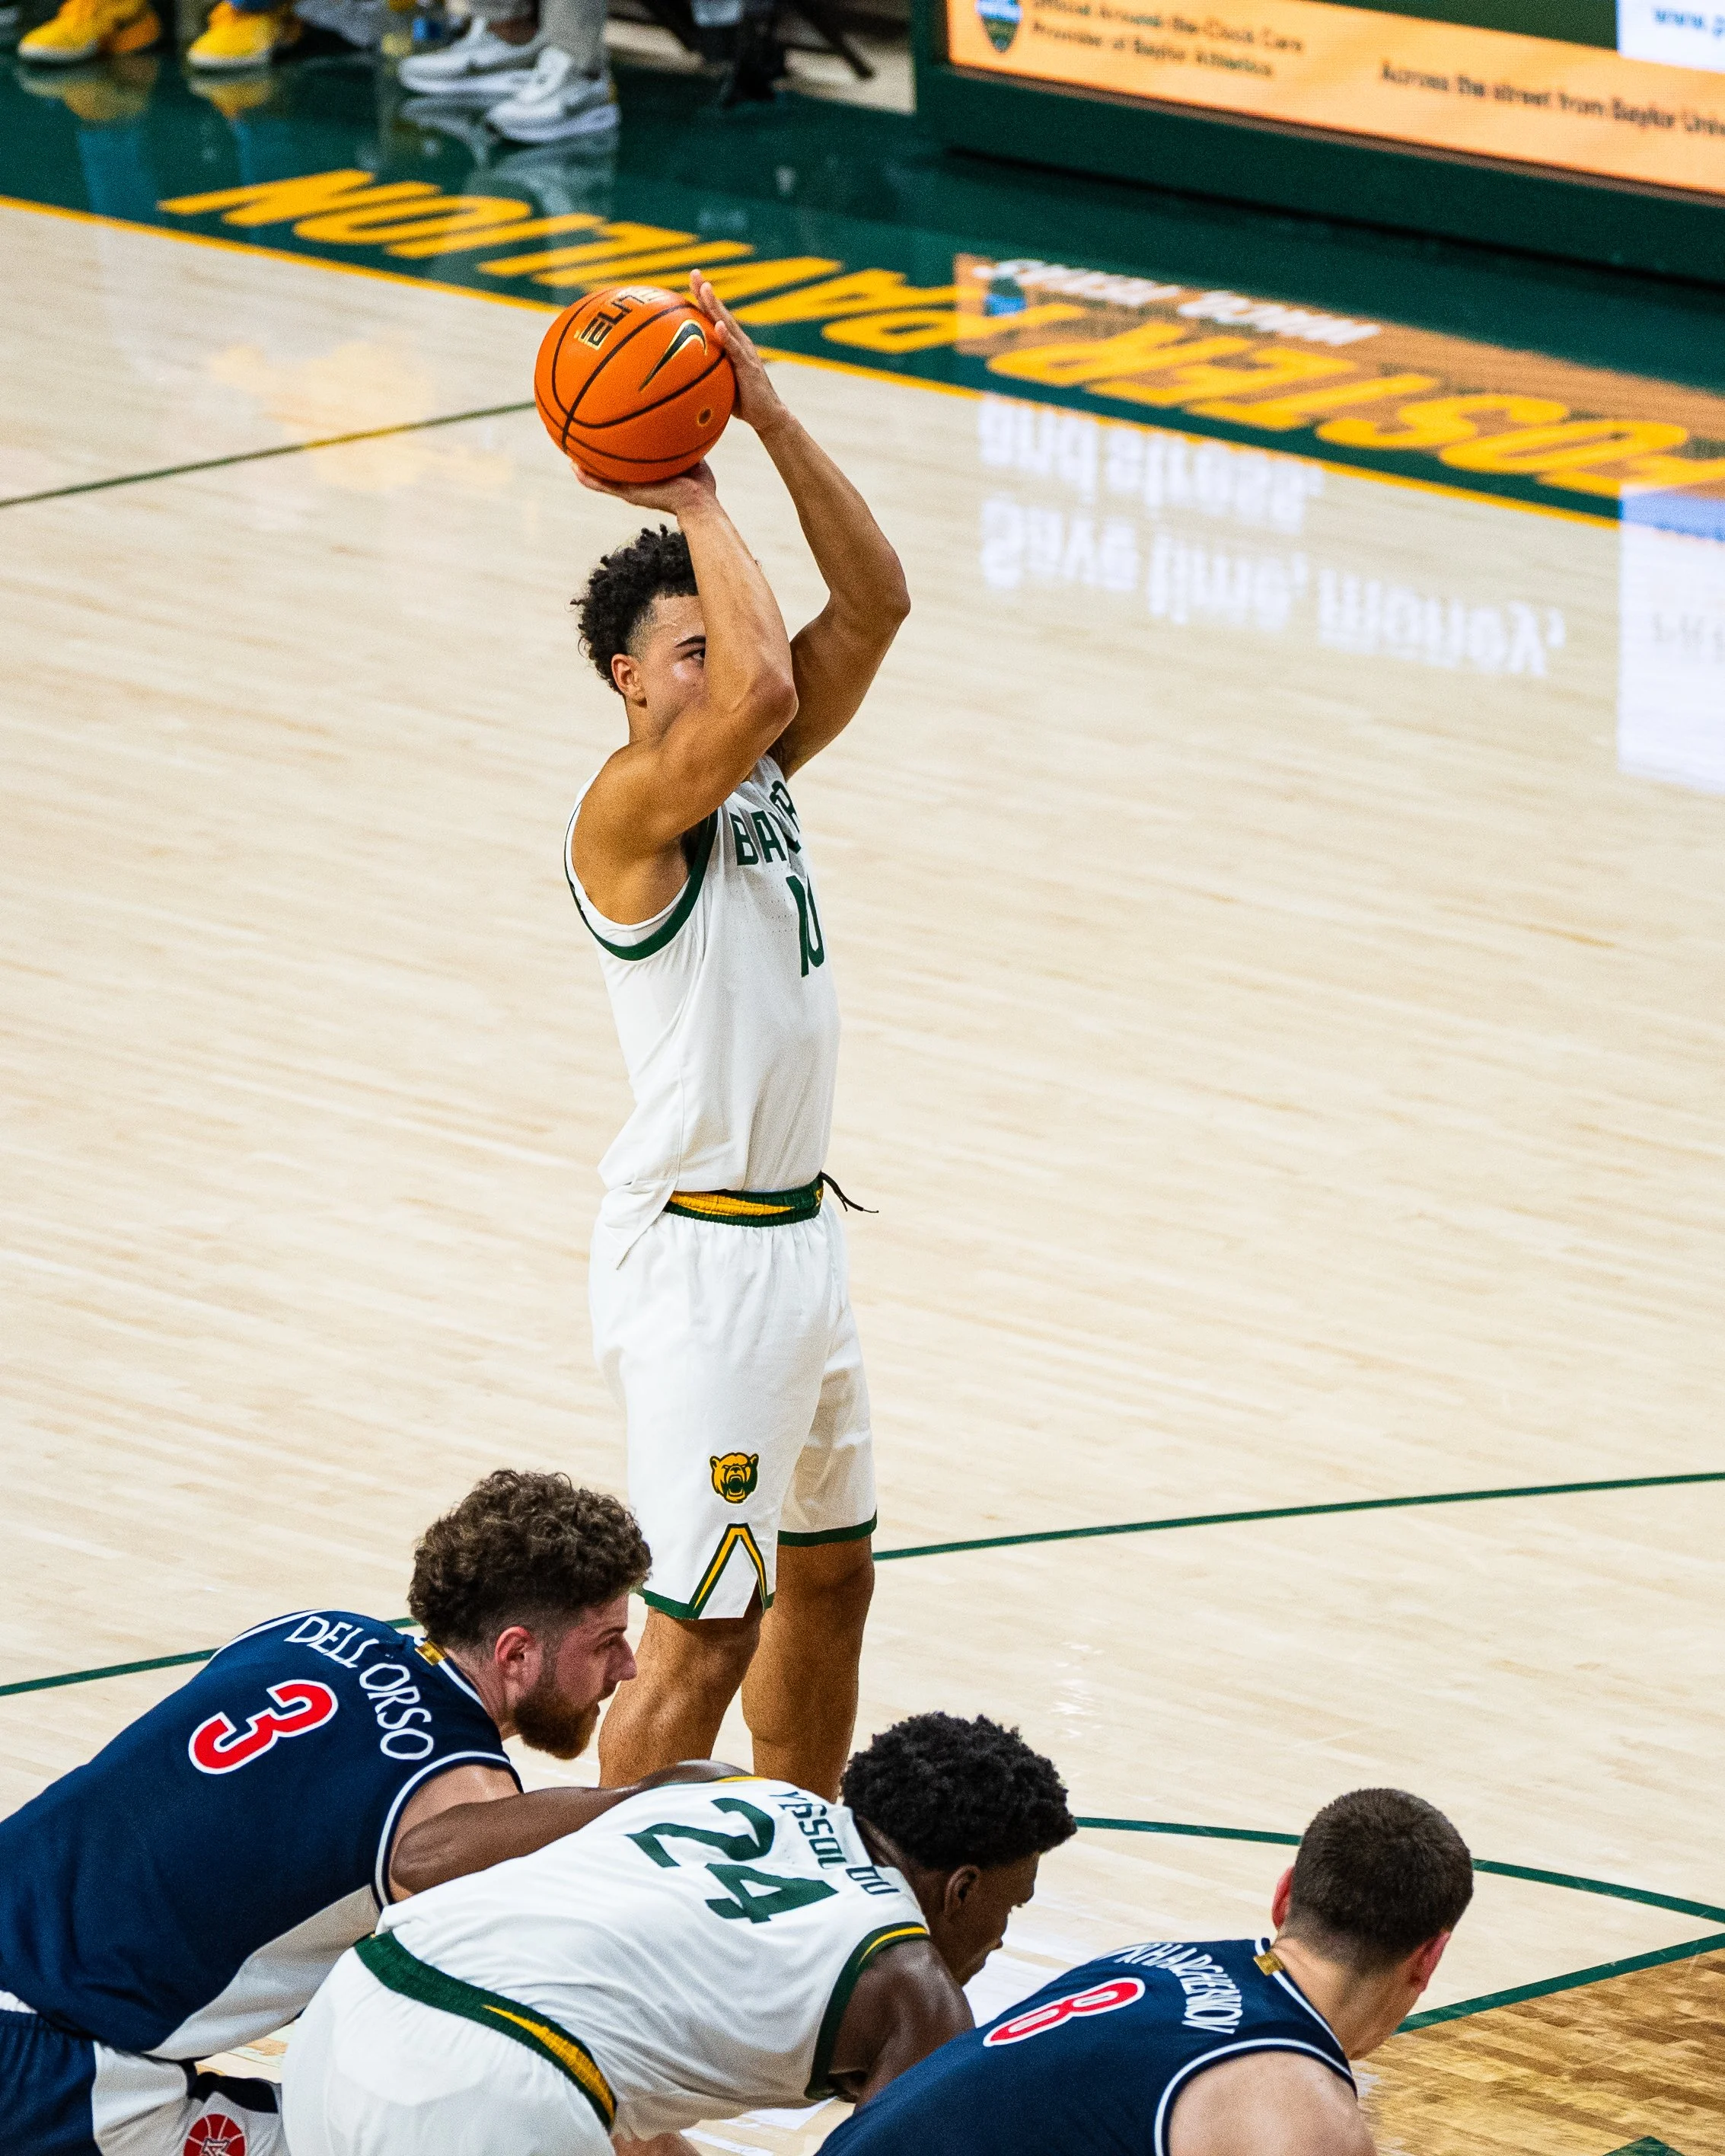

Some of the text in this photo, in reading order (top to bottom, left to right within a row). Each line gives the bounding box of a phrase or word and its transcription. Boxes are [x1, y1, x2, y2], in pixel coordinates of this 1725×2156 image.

[157, 168, 1086, 353] PAVILION
[785, 873, 825, 978] 10
[189, 1679, 339, 1775] 3
[359, 1663, 434, 1759] ORSO
[625, 1797, 839, 1925] 24
[983, 1977, 1146, 2047] 8
